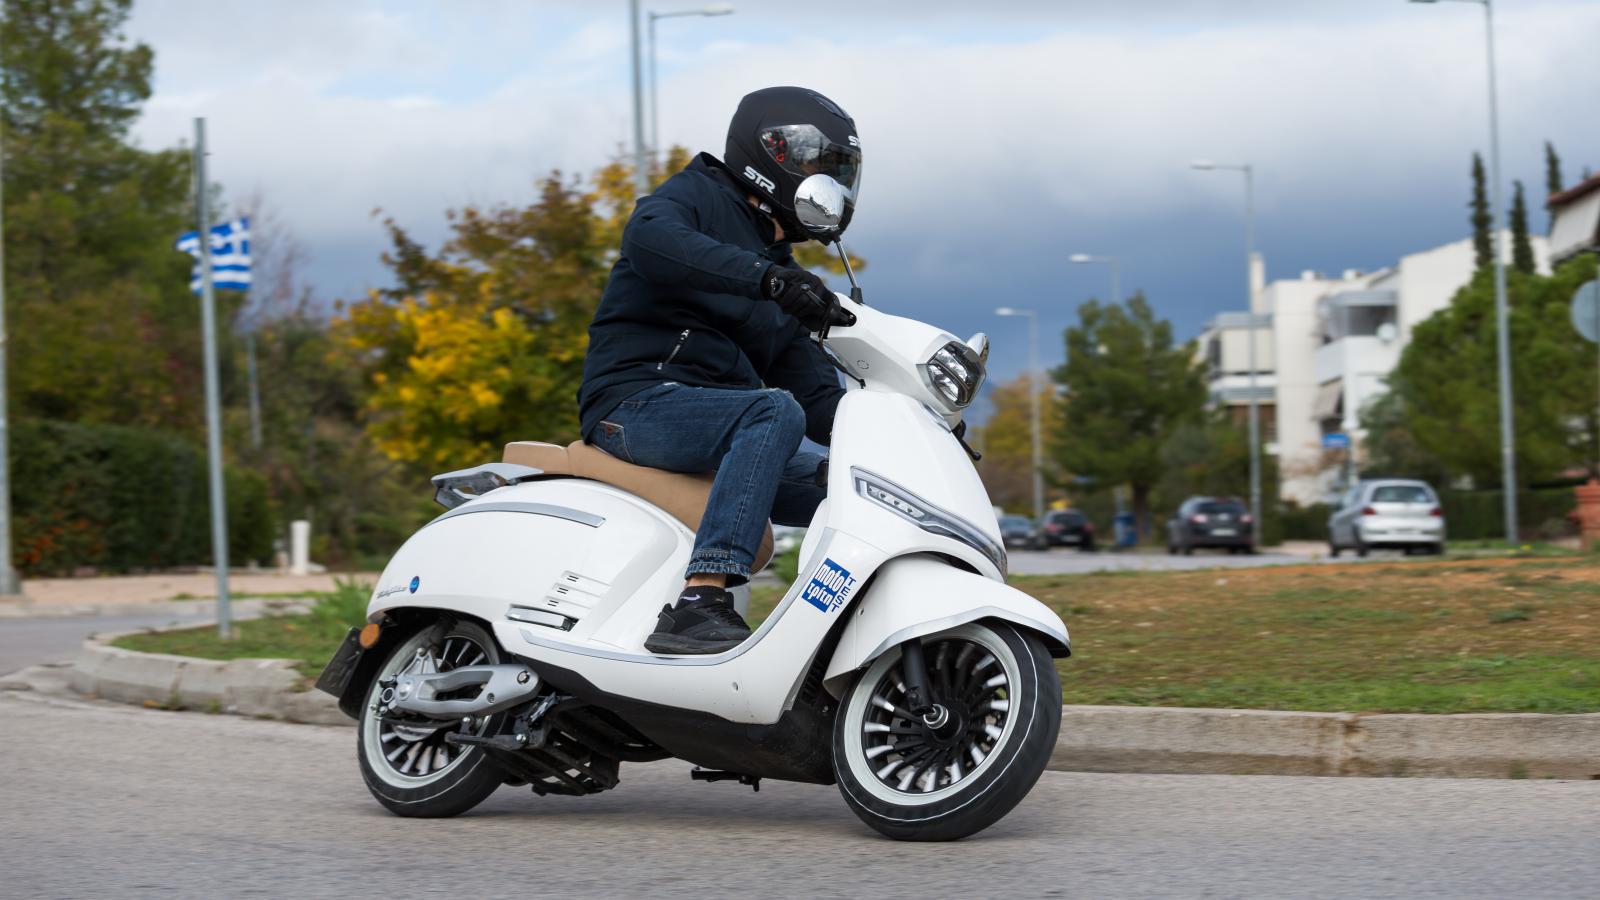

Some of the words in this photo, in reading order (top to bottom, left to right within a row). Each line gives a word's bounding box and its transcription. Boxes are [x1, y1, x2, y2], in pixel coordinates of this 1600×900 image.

[744, 165, 776, 194] STR
[815, 564, 845, 592] moto
[832, 577, 856, 612] TEST
